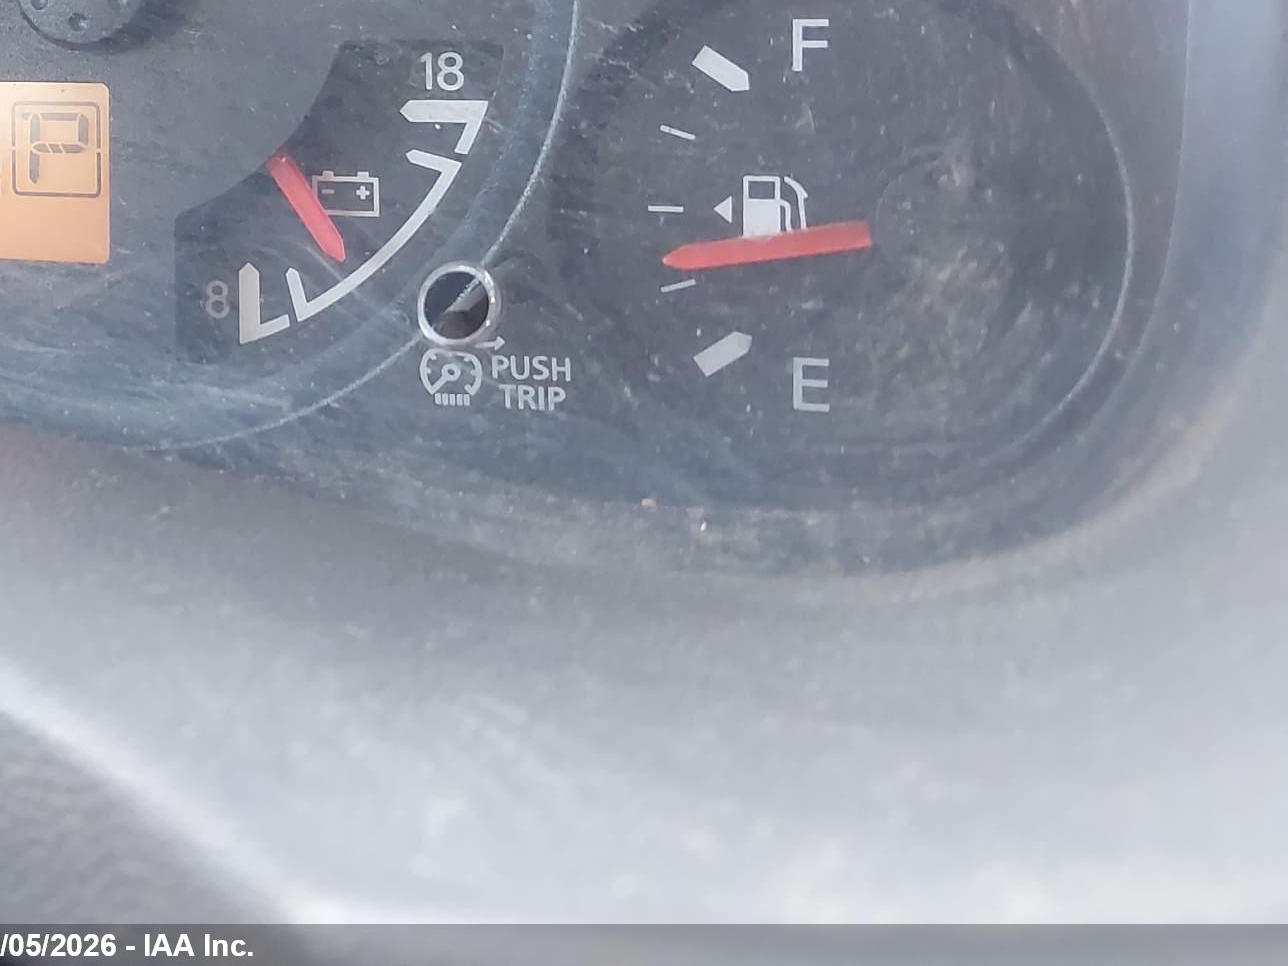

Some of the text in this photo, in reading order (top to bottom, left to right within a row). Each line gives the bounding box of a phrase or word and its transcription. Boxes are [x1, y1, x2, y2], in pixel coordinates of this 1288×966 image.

[791, 18, 829, 72] F
[420, 51, 465, 92] 18
[28, 112, 89, 184] P
[205, 280, 230, 319] 8
[491, 355, 571, 383] PUSH
[792, 357, 830, 413] E
[498, 382, 567, 411] TRIP
